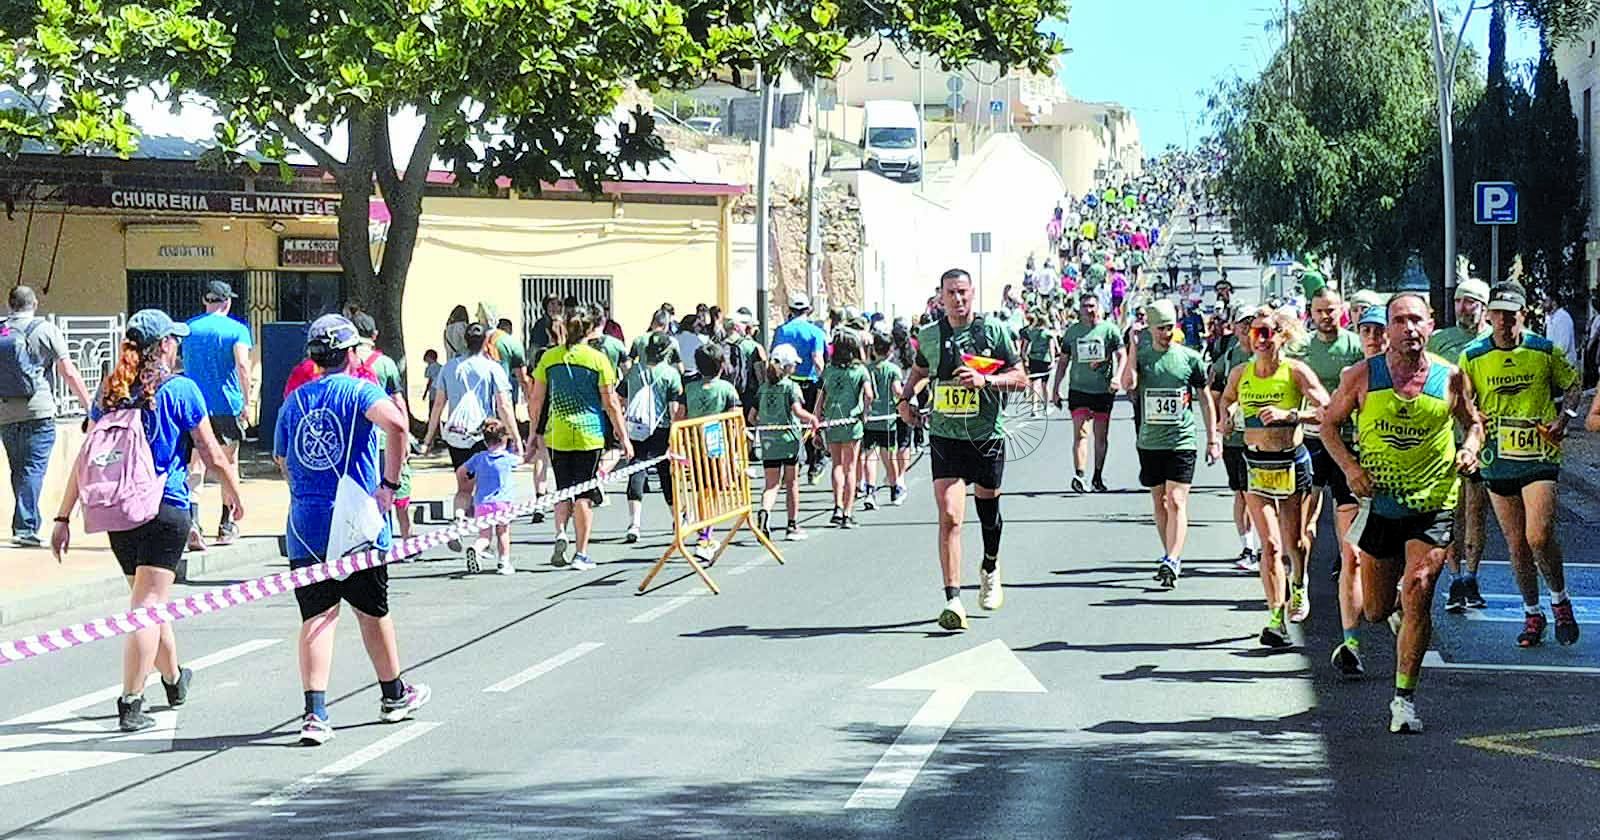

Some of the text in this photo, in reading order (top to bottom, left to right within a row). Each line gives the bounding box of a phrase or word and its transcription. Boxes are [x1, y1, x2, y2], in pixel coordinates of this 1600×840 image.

[111, 191, 209, 211] CHURRERIA
[230, 197, 254, 212] EL
[1483, 187, 1509, 219] P
[945, 389, 976, 405] 1672
[1156, 398, 1177, 414] 349
[1510, 430, 1541, 448] 1641
